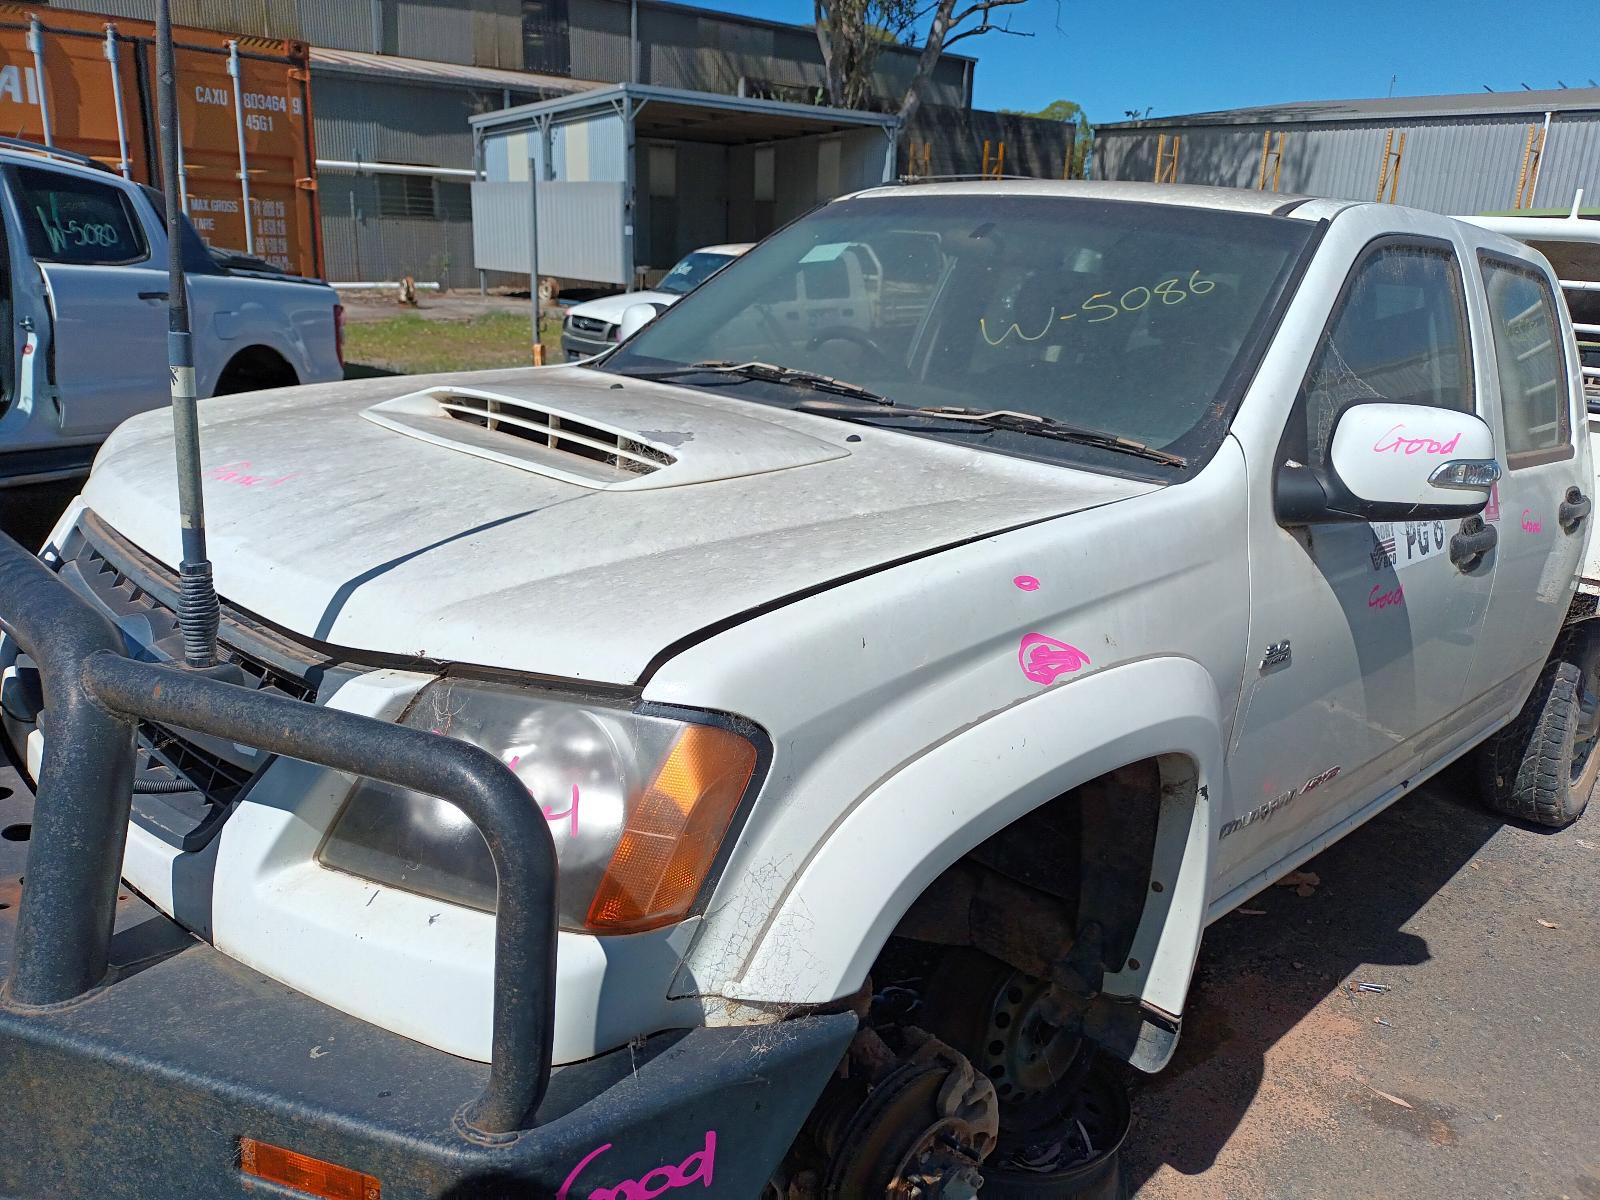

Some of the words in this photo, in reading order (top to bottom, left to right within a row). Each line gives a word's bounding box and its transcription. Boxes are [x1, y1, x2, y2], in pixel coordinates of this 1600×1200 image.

[195, 86, 228, 106] CAXU
[243, 93, 287, 112] 803464
[979, 269, 1216, 346] W-5086
[1373, 424, 1462, 456] Good
[1368, 583, 1405, 609] Good
